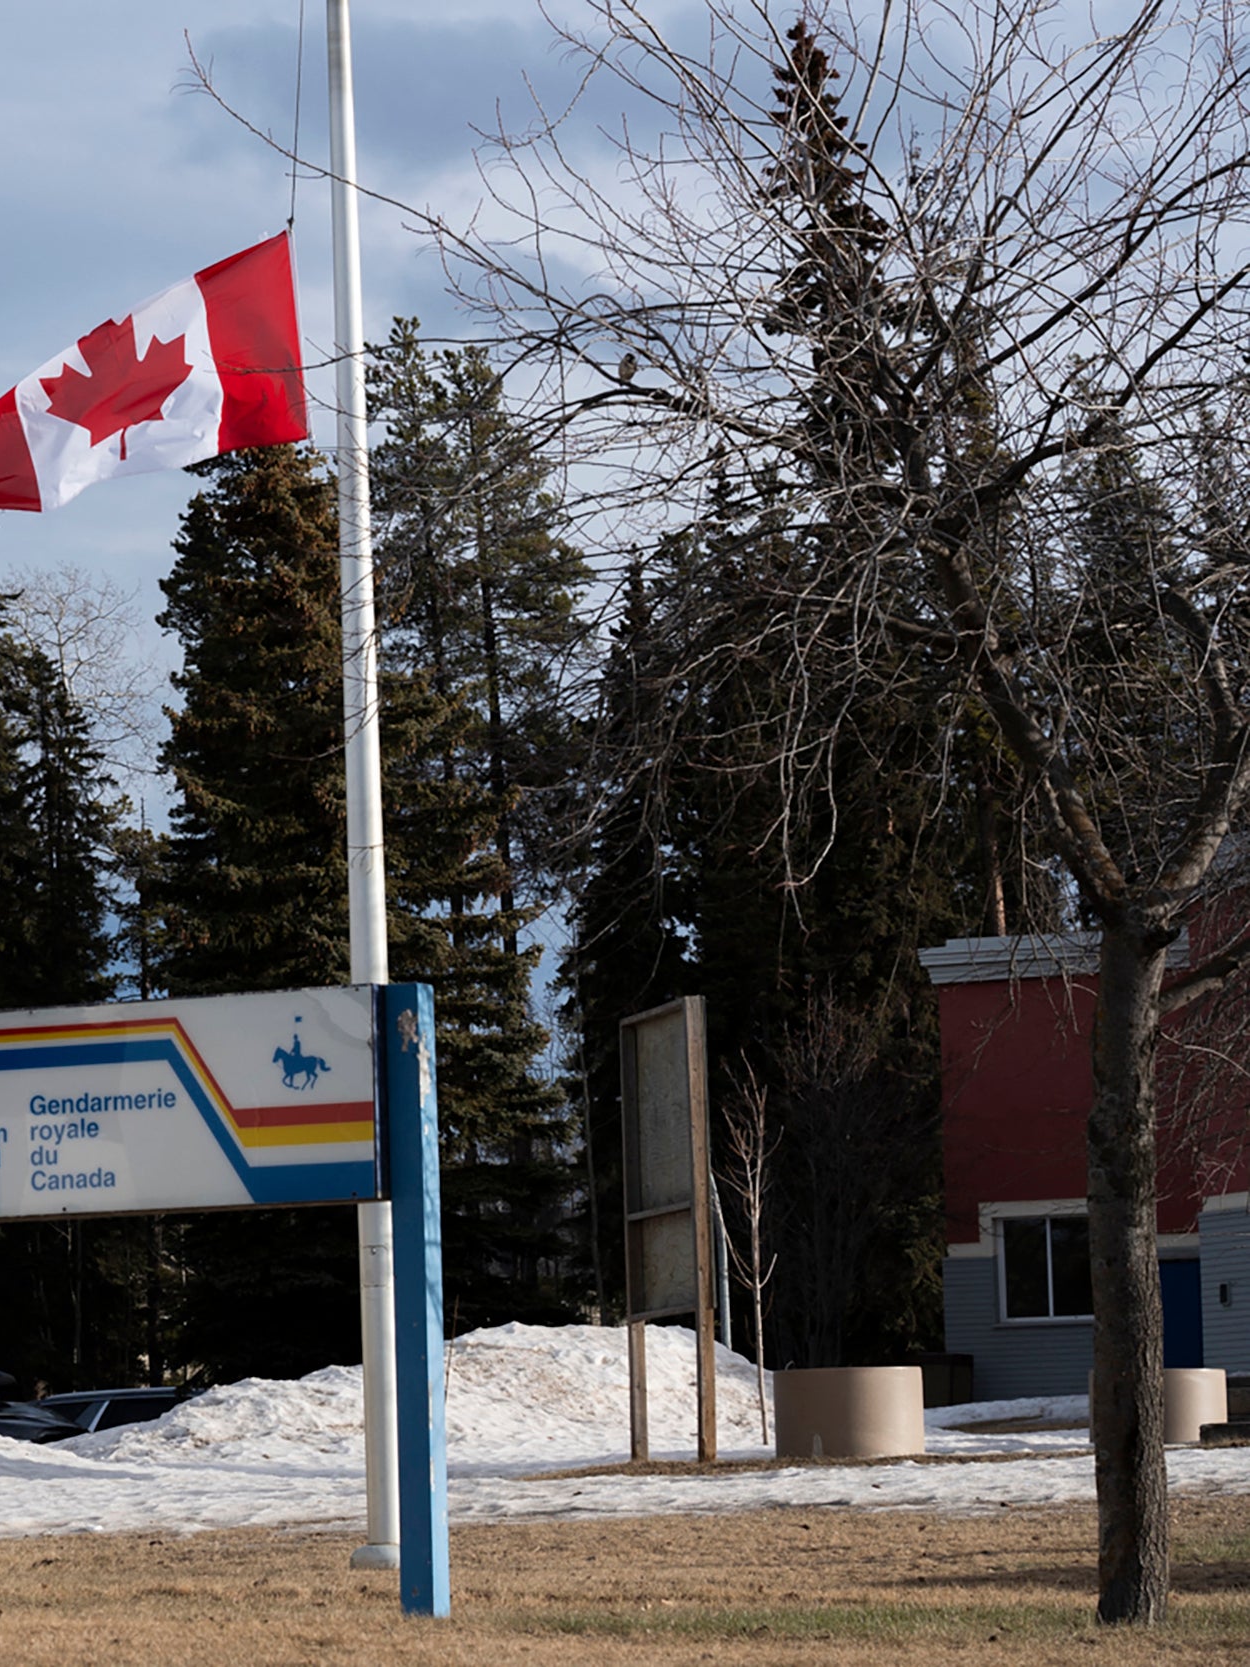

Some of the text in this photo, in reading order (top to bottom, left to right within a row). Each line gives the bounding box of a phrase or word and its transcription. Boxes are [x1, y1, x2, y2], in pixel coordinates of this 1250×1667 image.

[29, 1088, 177, 1116] Gendarmerie
[30, 1118, 100, 1145] royale
[30, 1146, 58, 1166] du
[31, 1168, 116, 1191] Canada
